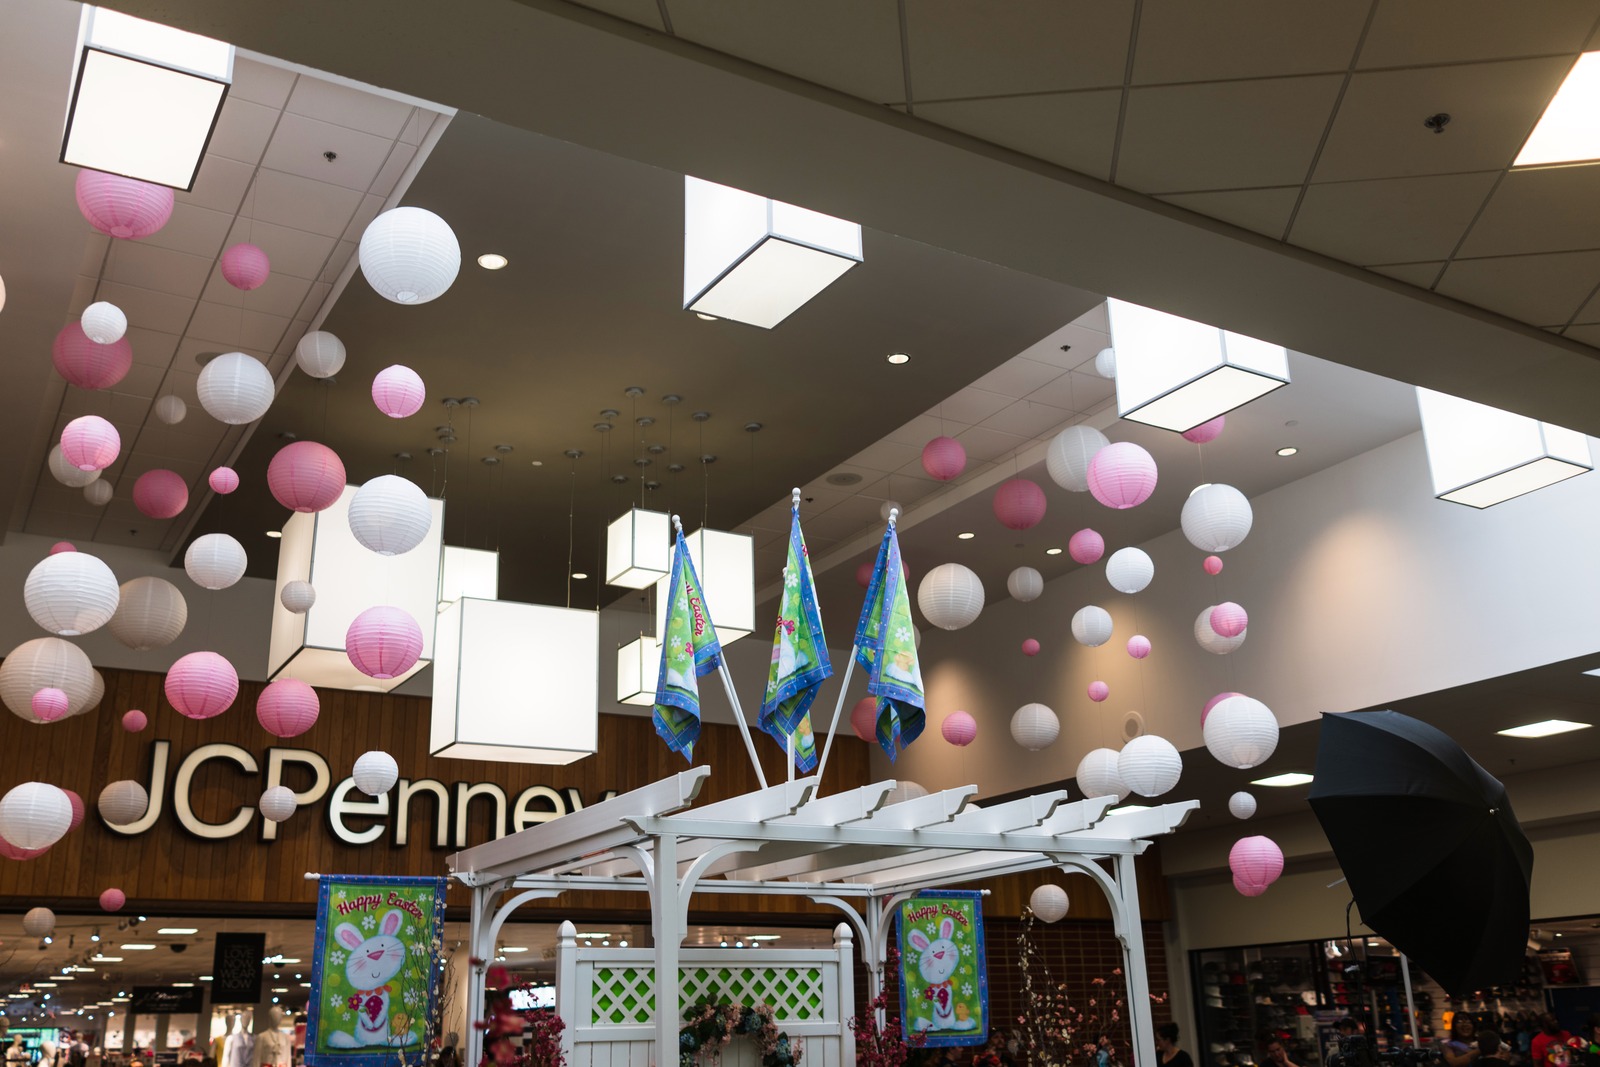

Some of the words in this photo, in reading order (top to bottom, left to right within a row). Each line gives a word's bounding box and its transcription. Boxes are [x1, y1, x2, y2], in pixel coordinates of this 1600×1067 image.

[690, 597, 706, 637] Easter
[337, 892, 383, 916] Happy
[386, 890, 425, 920] Easter
[907, 904, 939, 923] Happy
[941, 902, 969, 927] Easter
[224, 948, 255, 958] LOVE
[224, 959, 254, 968] NOW
[219, 968, 256, 978] WEAR
[222, 978, 252, 988] NOW
